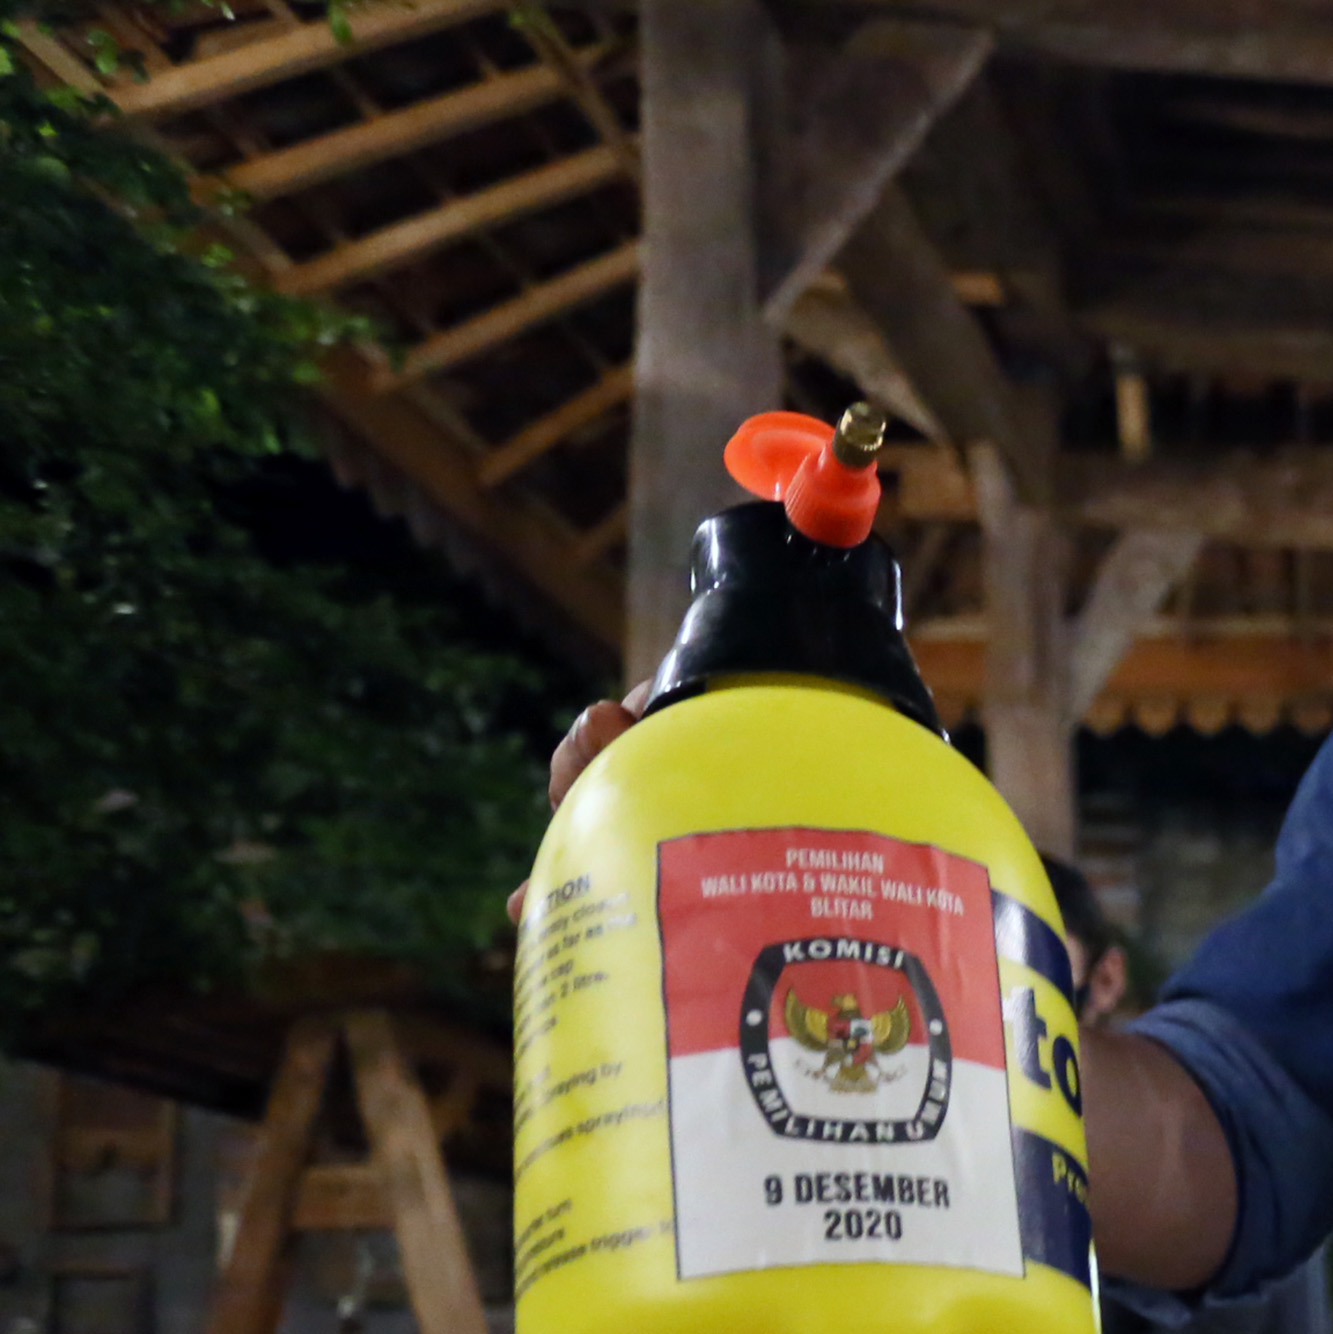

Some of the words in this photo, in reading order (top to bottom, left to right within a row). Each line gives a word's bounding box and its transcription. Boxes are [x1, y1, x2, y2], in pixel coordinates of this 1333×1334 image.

[786, 848, 884, 874] PEMILIHAN
[701, 876, 745, 898] WALI
[752, 873, 798, 892] KOTA
[803, 873, 816, 892] &
[821, 874, 874, 897] WAKIL
[881, 879, 922, 903] WALI
[926, 889, 964, 916] KOTA
[811, 897, 873, 920] BLITAR
[783, 938, 905, 969] KOMISI
[747, 1053, 895, 1140] PEMILIHAN
[764, 1175, 783, 1207] 9
[794, 1173, 950, 1208] DESEMBER
[825, 1210, 903, 1240] 2020
